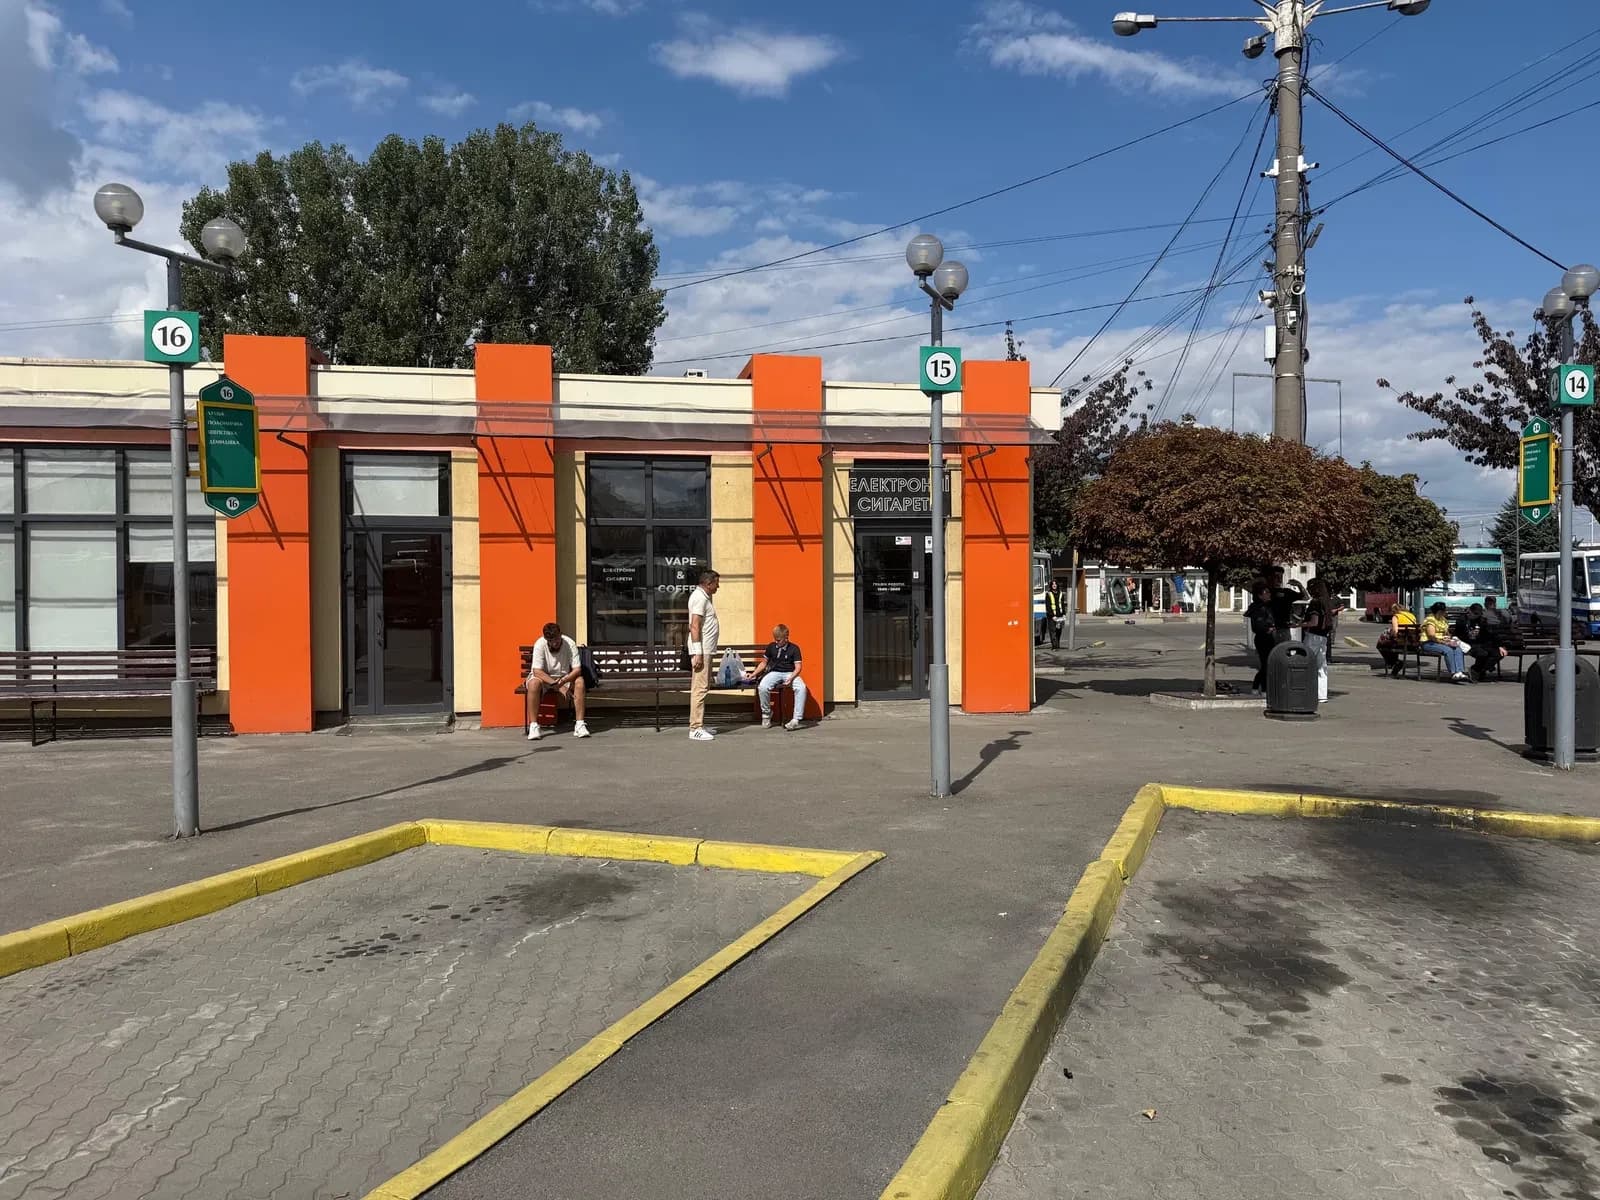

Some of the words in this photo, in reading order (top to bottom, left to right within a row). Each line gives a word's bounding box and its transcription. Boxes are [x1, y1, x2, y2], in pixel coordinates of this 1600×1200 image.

[157, 325, 186, 347] 16
[930, 359, 951, 378] 15
[1569, 376, 1586, 393] 14
[223, 389, 233, 398] 16
[849, 474, 950, 493] ЕЛЕКТРОНІ
[229, 499, 238, 508] 16
[857, 497, 933, 512] СИГАРЕТ
[664, 556, 697, 566] VAPE
[676, 570, 685, 579] &
[657, 584, 699, 593] COFFE
